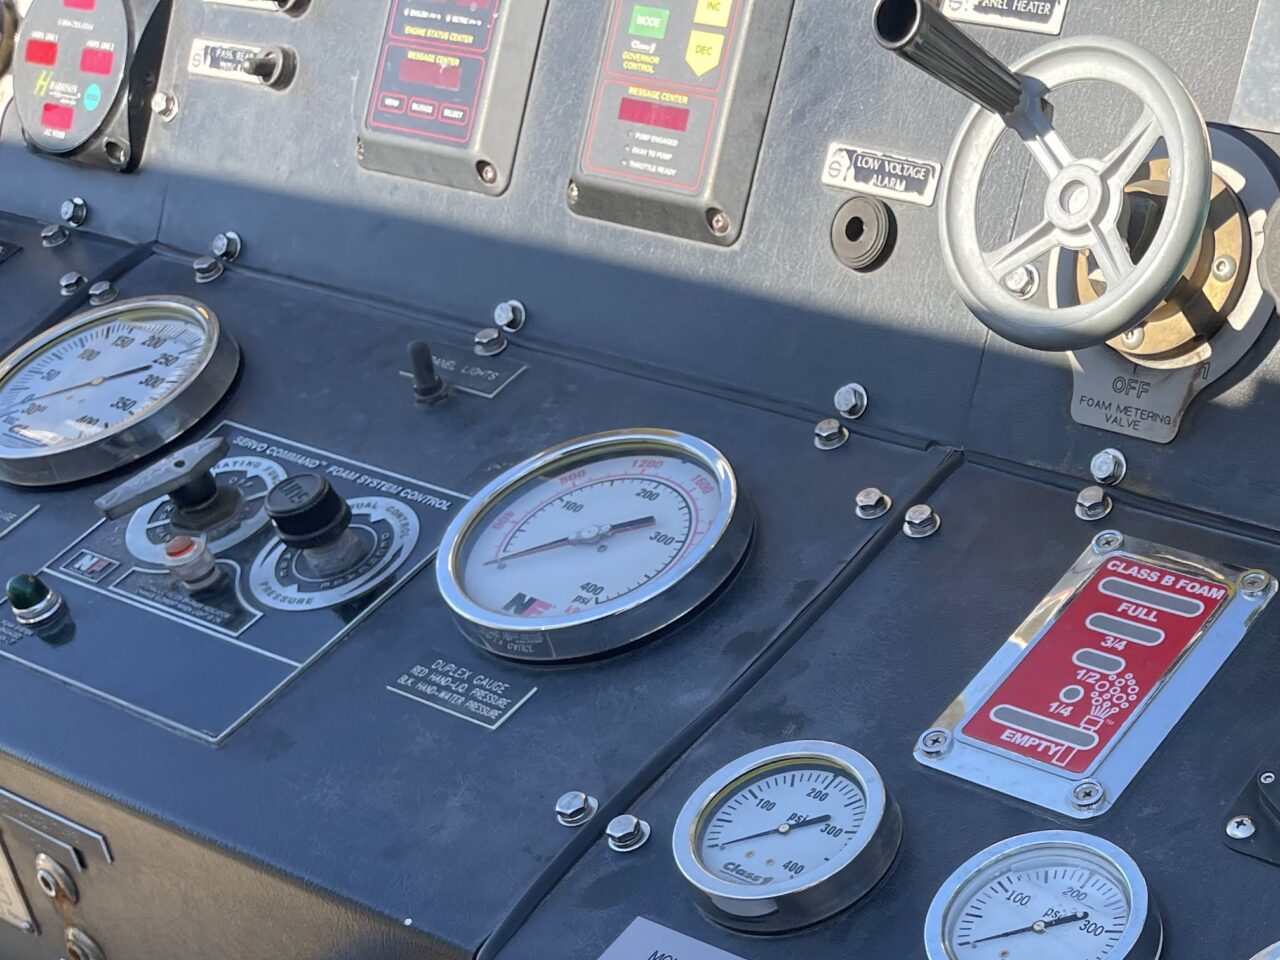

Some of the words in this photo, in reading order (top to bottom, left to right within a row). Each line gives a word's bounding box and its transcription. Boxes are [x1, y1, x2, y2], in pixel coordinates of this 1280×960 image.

[1013, 0, 1050, 15] HEATER
[636, 15, 661, 28] MODE
[695, 45, 713, 56] DEC
[628, 86, 660, 100] MESSAGE
[661, 92, 689, 104] CENTER
[857, 155, 879, 171] LOW
[884, 160, 926, 179] VOLTAGE
[872, 173, 906, 191] ALARM
[111, 336, 135, 348] 150
[152, 353, 179, 366] 250
[139, 375, 166, 388] 300
[1112, 376, 1151, 399] OFF
[1079, 395, 1111, 411] FOAM
[1116, 405, 1171, 425] METERING
[1105, 413, 1141, 431] VALVE
[233, 435, 267, 456] SERVO
[326, 465, 357, 482] FOAM
[355, 473, 403, 495] SYSTEM
[399, 488, 452, 511] CONTROL
[635, 487, 658, 501] 200
[561, 500, 584, 514] 100
[649, 531, 675, 546] 300
[1106, 560, 1161, 586] CLASS
[1160, 574, 1177, 588] B
[1175, 578, 1227, 601] FOAM
[259, 581, 315, 605] PRESSURE
[580, 581, 605, 596] 400
[1116, 602, 1160, 623] FULL
[1100, 636, 1127, 651] 3/4
[431, 659, 473, 680] DUPLEX
[473, 675, 510, 694] GAUGE
[1076, 669, 1099, 684] 1/2
[469, 688, 511, 708] PRESSURE
[464, 700, 502, 719] PRESSURE
[1049, 701, 1073, 717] 1/4
[1000, 729, 1061, 757] EMPTY
[806, 787, 828, 802] 200
[756, 797, 777, 812] 100
[820, 823, 843, 838] 300
[782, 861, 805, 875] 400
[1005, 889, 1031, 906] 100
[1061, 887, 1088, 901] 200
[1079, 919, 1105, 937] 300
